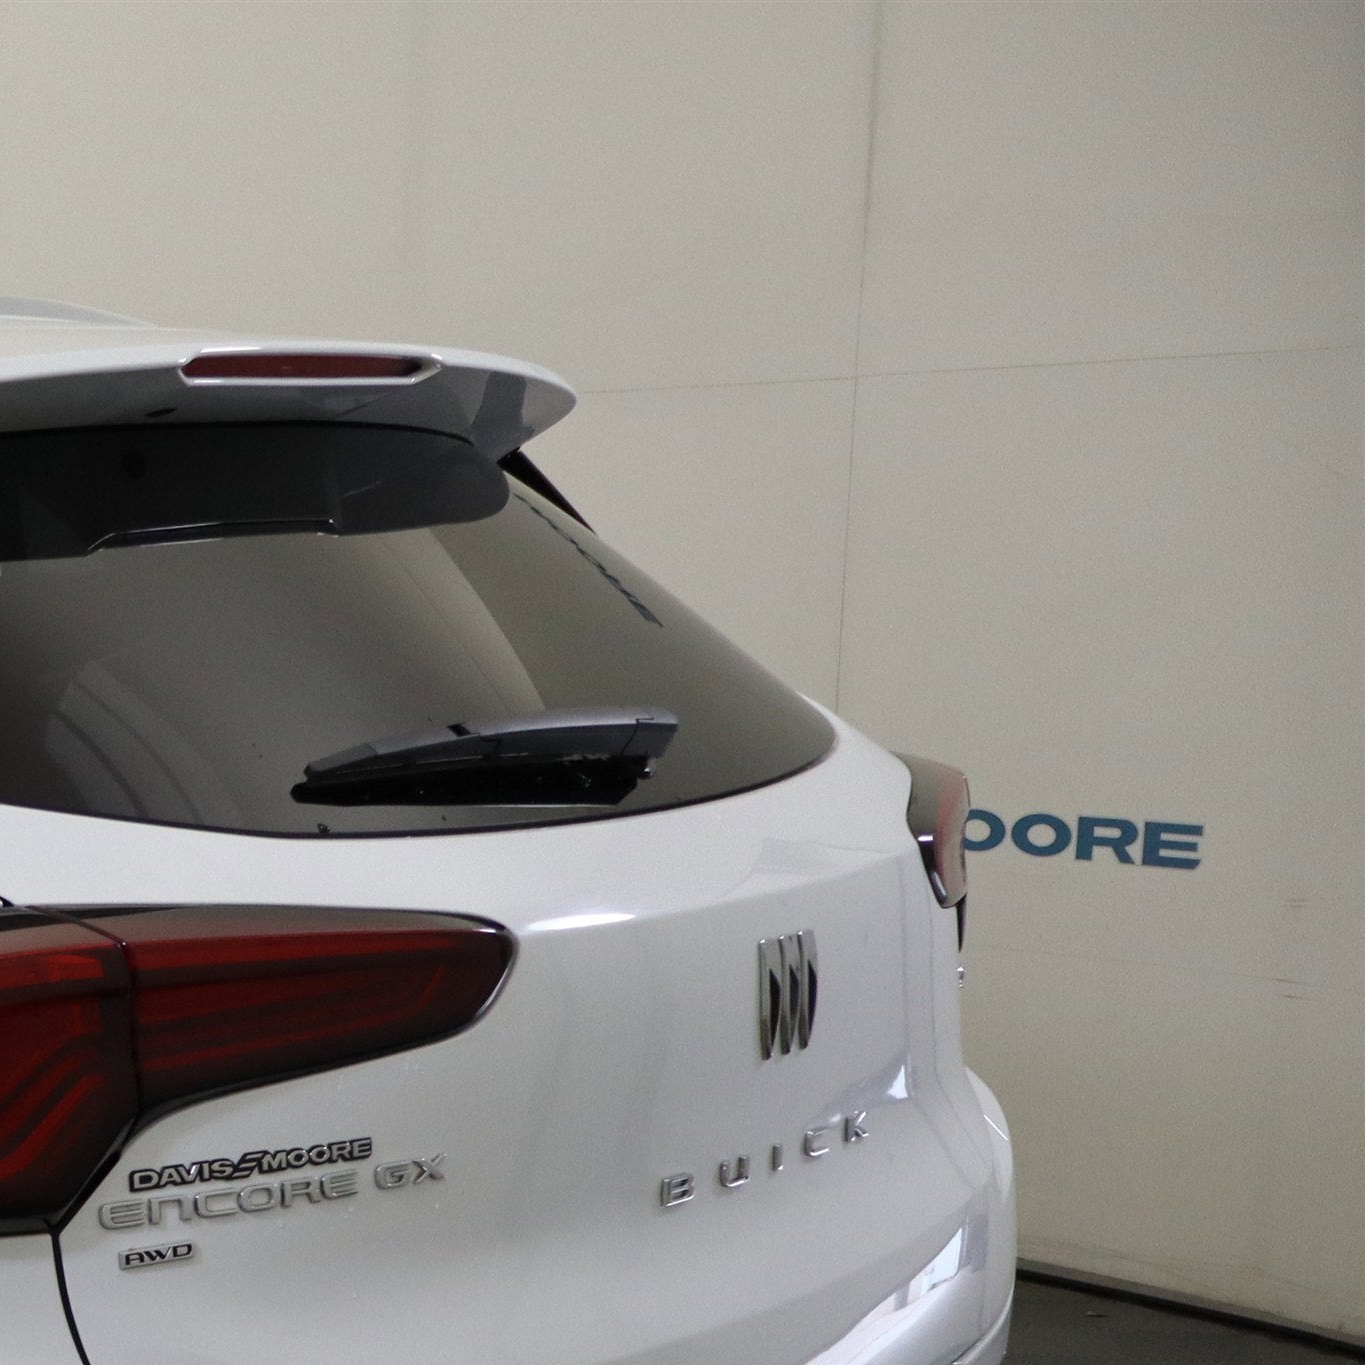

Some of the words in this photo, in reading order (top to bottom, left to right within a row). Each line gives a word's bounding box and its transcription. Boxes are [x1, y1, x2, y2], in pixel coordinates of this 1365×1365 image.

[963, 808, 1205, 870] OORE
[98, 1167, 360, 1231] ENCORE
[374, 1152, 448, 1191] GX
[660, 1110, 869, 1208] BUICK
[124, 1243, 194, 1267] AWD
